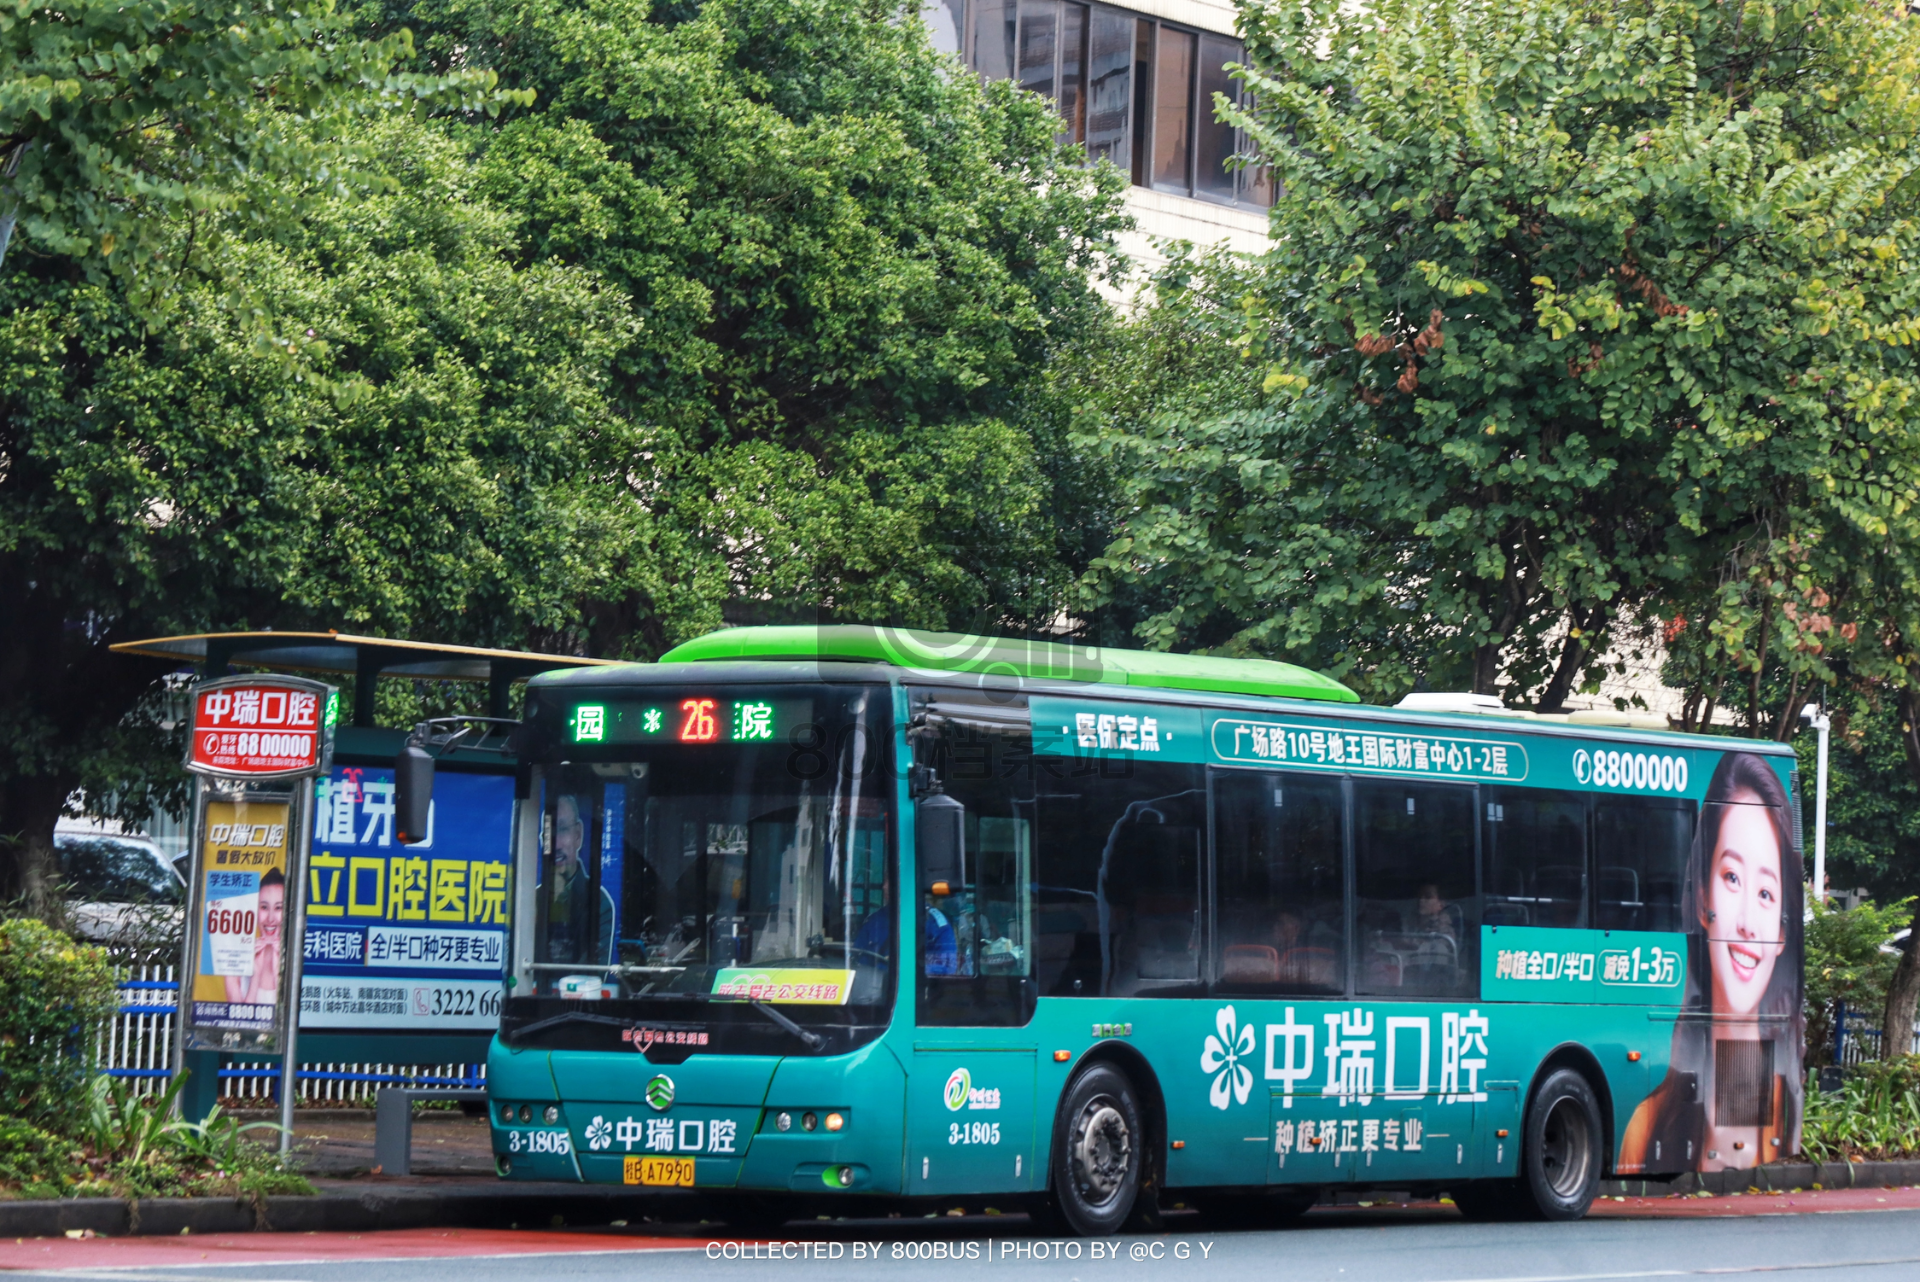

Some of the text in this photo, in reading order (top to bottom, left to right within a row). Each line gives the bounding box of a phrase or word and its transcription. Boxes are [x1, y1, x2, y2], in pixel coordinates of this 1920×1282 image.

[205, 690, 316, 726] 中瑞口腔
[681, 700, 715, 740] 26
[1076, 713, 1160, 752] 医保定点
[1233, 725, 1509, 776] 广场路10号地王国际财富中心1-2层
[1592, 750, 1688, 792] 8800000
[315, 778, 434, 848] 植牙
[209, 823, 285, 847] 中瑞口腔
[209, 872, 253, 887] 学生矫正
[307, 851, 507, 923] 立口腔医院
[207, 909, 255, 935] 6600
[370, 933, 500, 963] 全/半口种牙更专业
[1495, 949, 1595, 981] 种植全口/半口
[1603, 946, 1675, 982] 减免1-3万
[432, 989, 475, 1016] 3222
[1263, 1006, 1489, 1108] 中瑞口腔
[508, 1130, 570, 1155] 3-1805
[616, 1116, 736, 1153] 中瑞口腔
[948, 1121, 1001, 1146] 3-1805
[1274, 1117, 1424, 1155] 种植矫正更专业
